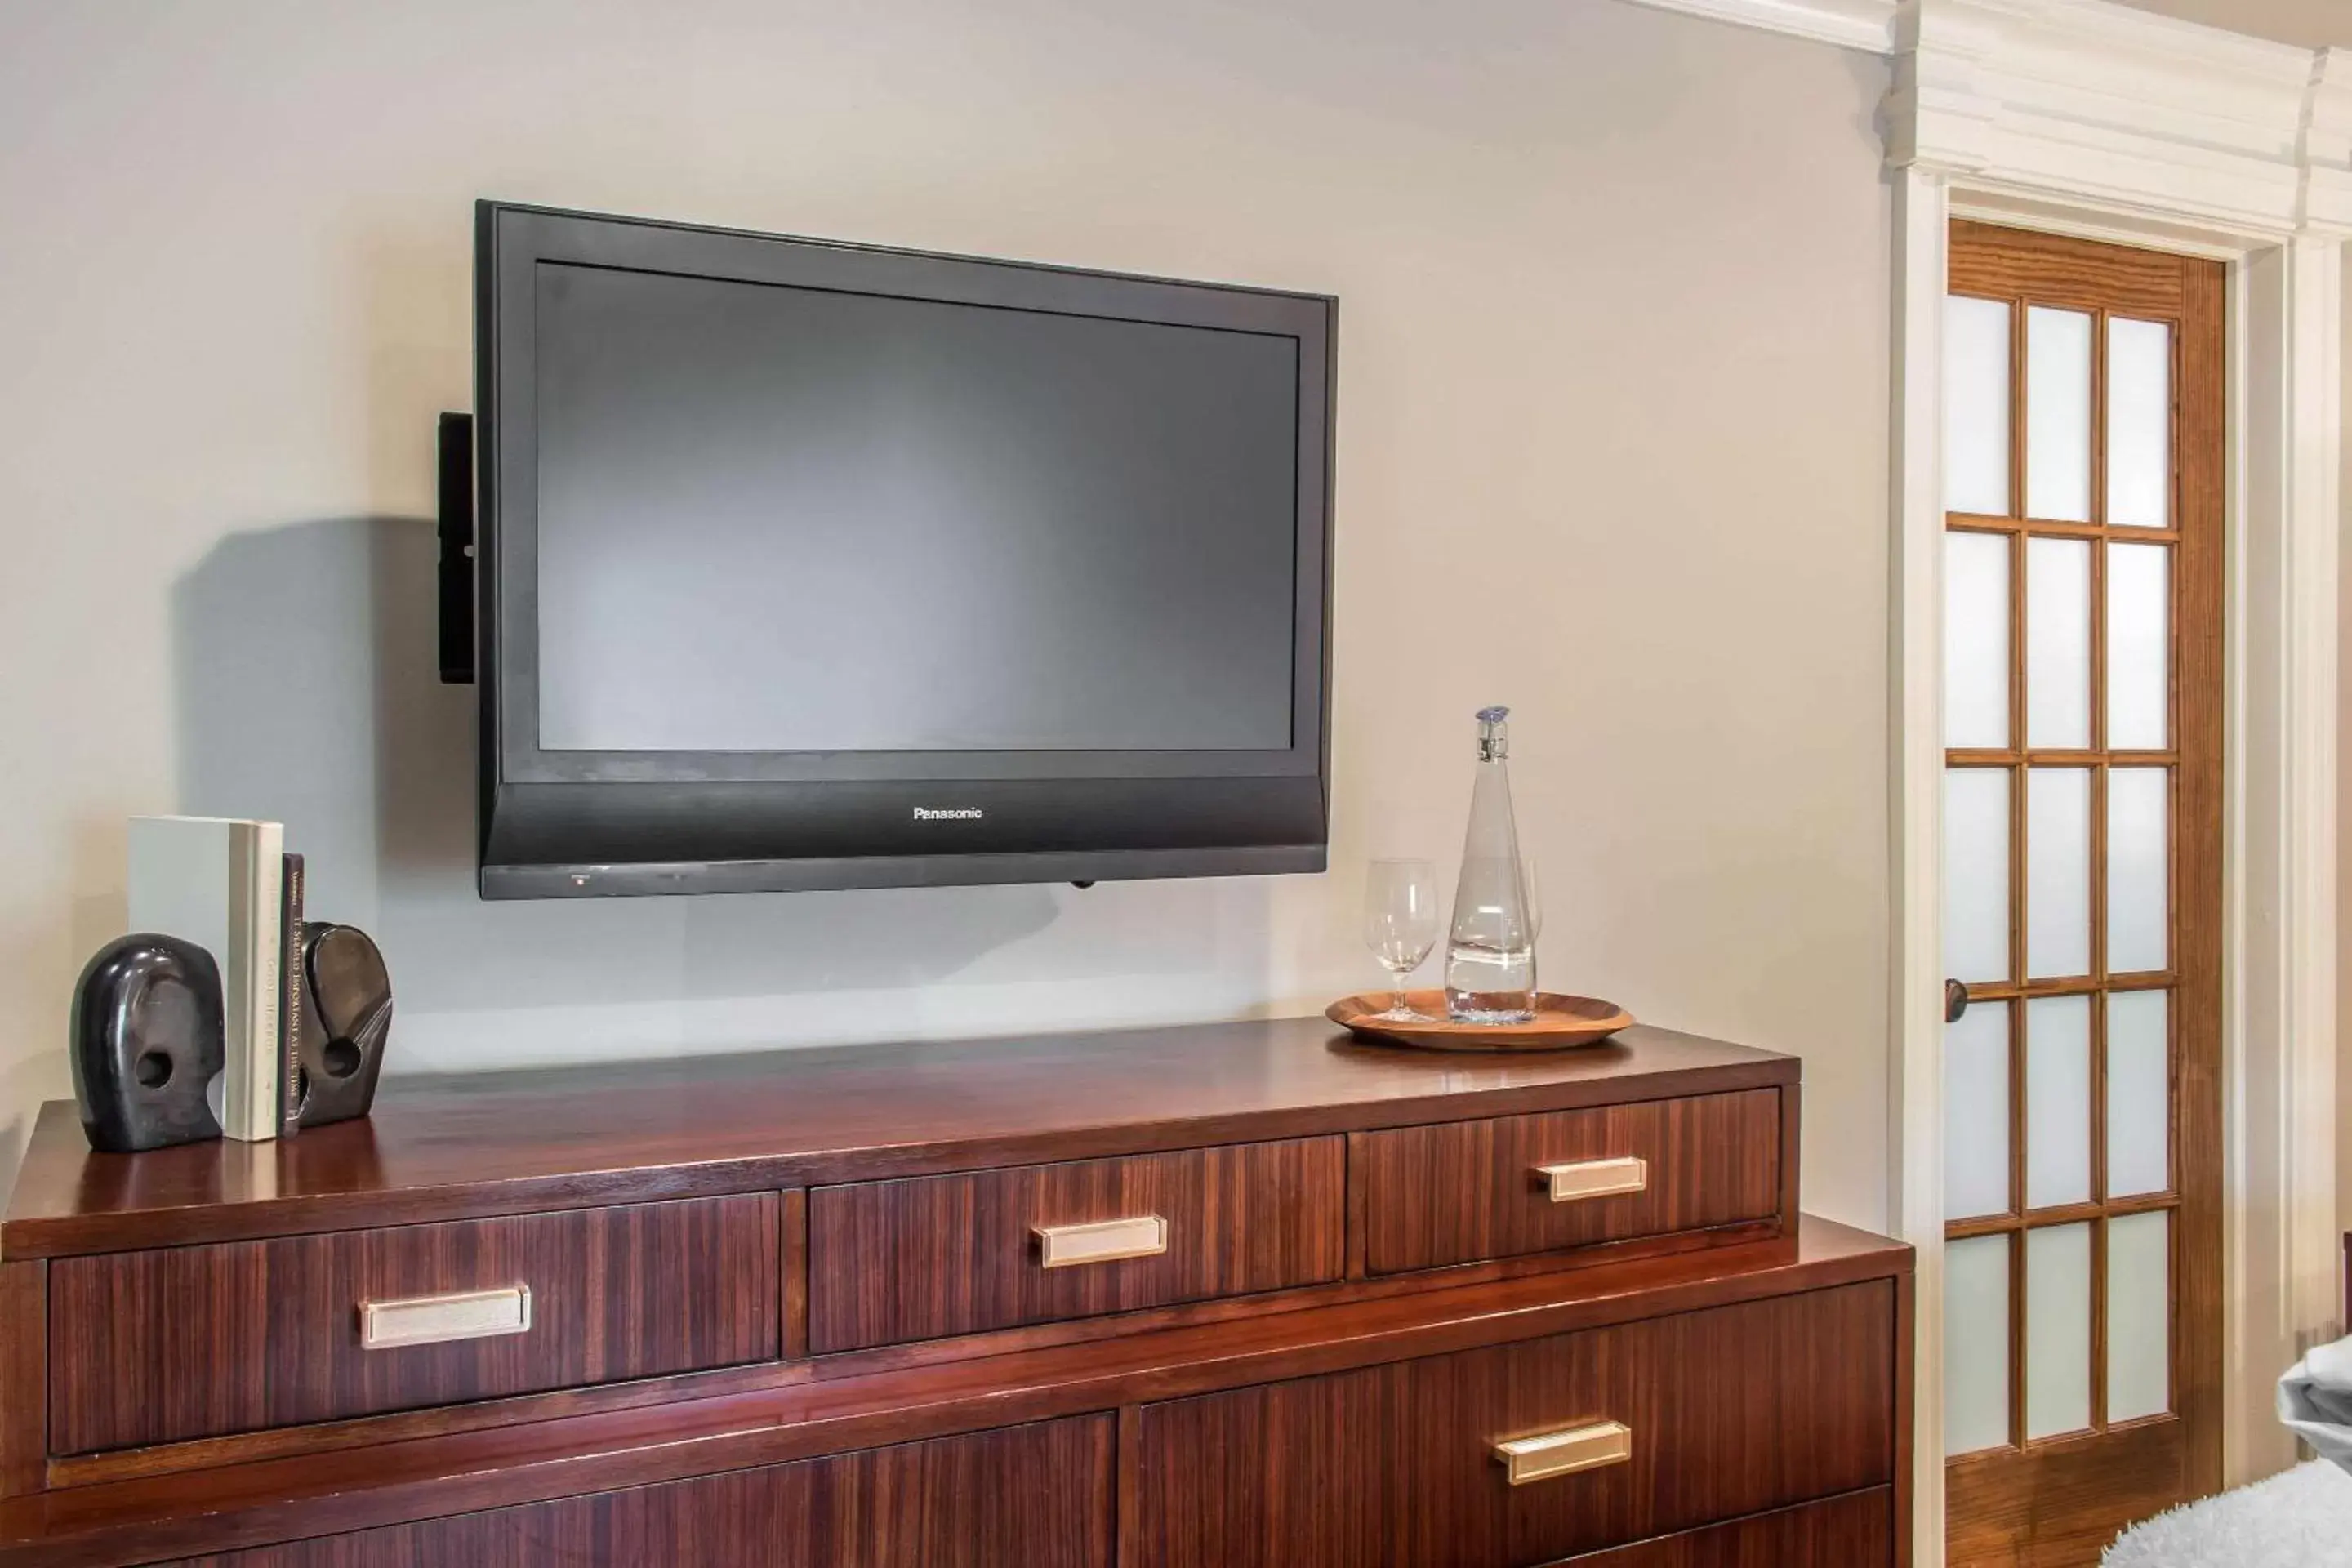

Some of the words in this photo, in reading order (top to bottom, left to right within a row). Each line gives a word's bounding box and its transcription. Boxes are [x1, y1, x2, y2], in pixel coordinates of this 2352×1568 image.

[914, 807, 982, 819] Panasonic
[292, 974, 301, 1031] IMPORTANT
[290, 1074, 298, 1097] TIME
